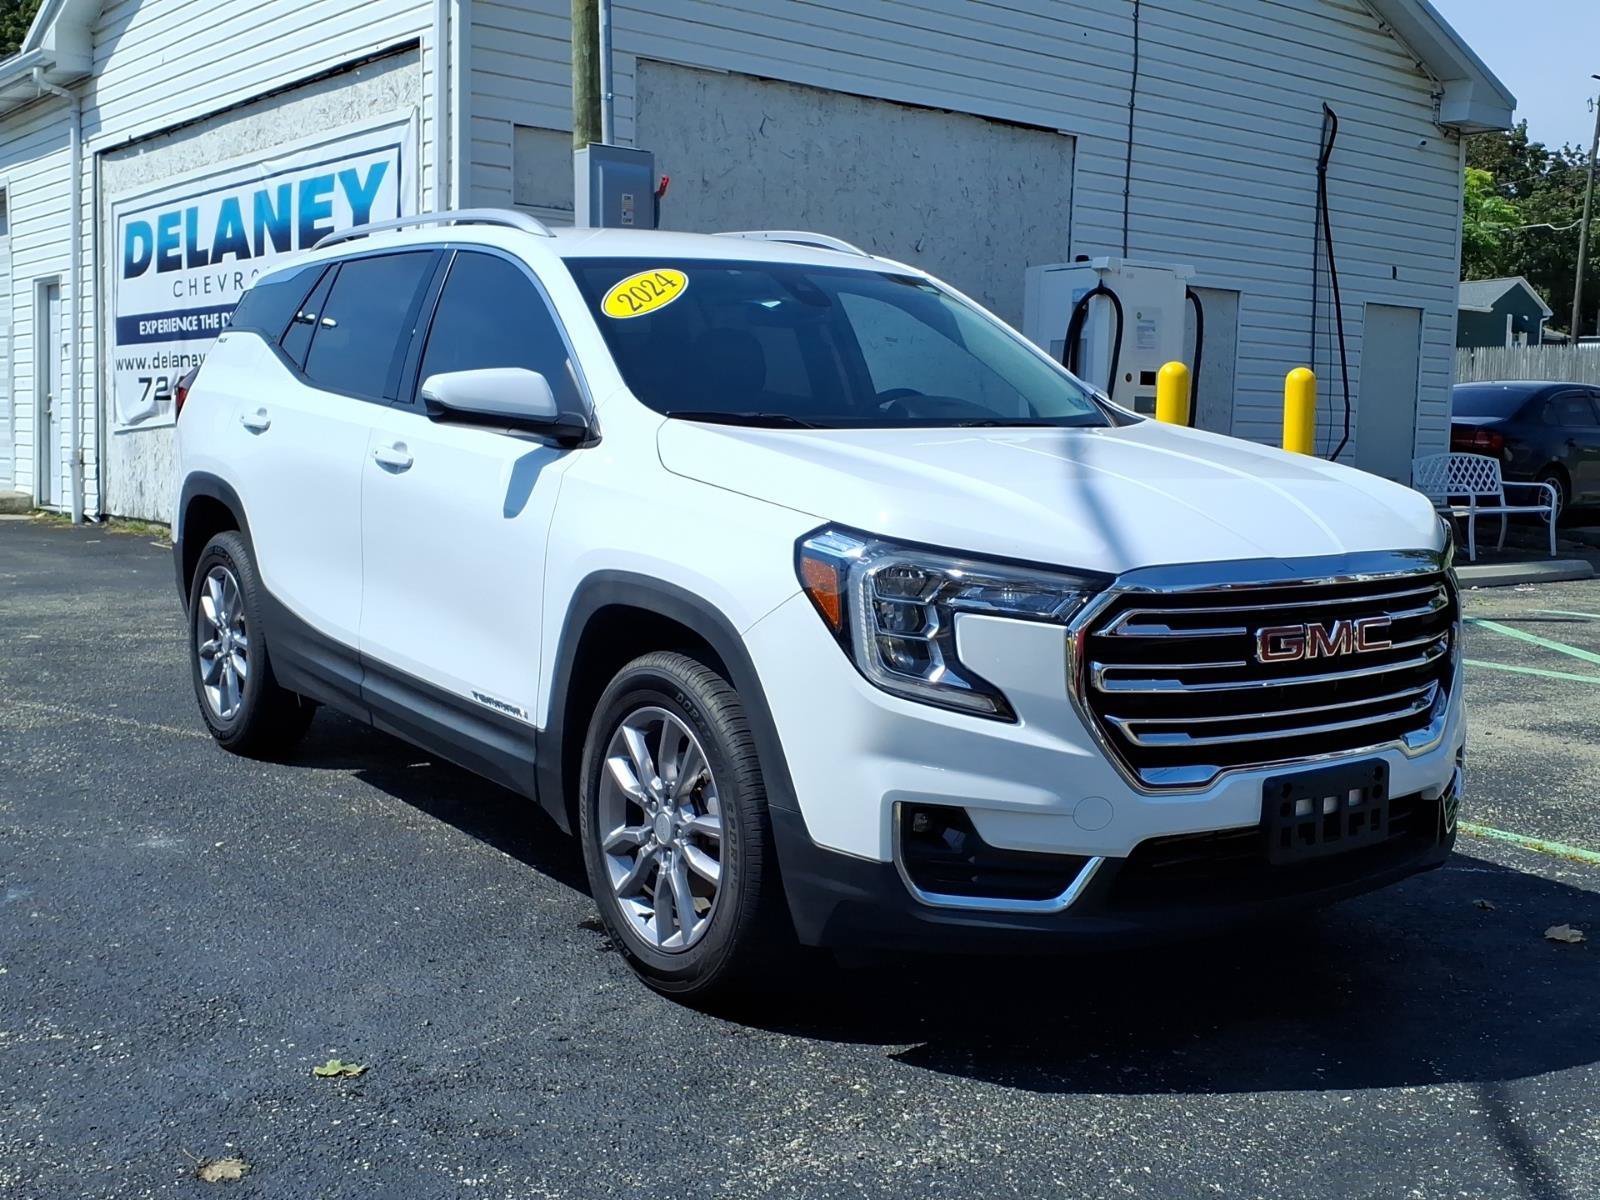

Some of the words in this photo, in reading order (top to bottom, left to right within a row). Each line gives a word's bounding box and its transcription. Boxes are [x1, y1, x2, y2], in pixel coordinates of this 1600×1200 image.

[123, 160, 390, 279] DELANEY
[617, 273, 677, 312] 2024
[139, 315, 198, 335] EXPERIENCE
[199, 313, 219, 330] THE
[1256, 616, 1392, 663] GMC
